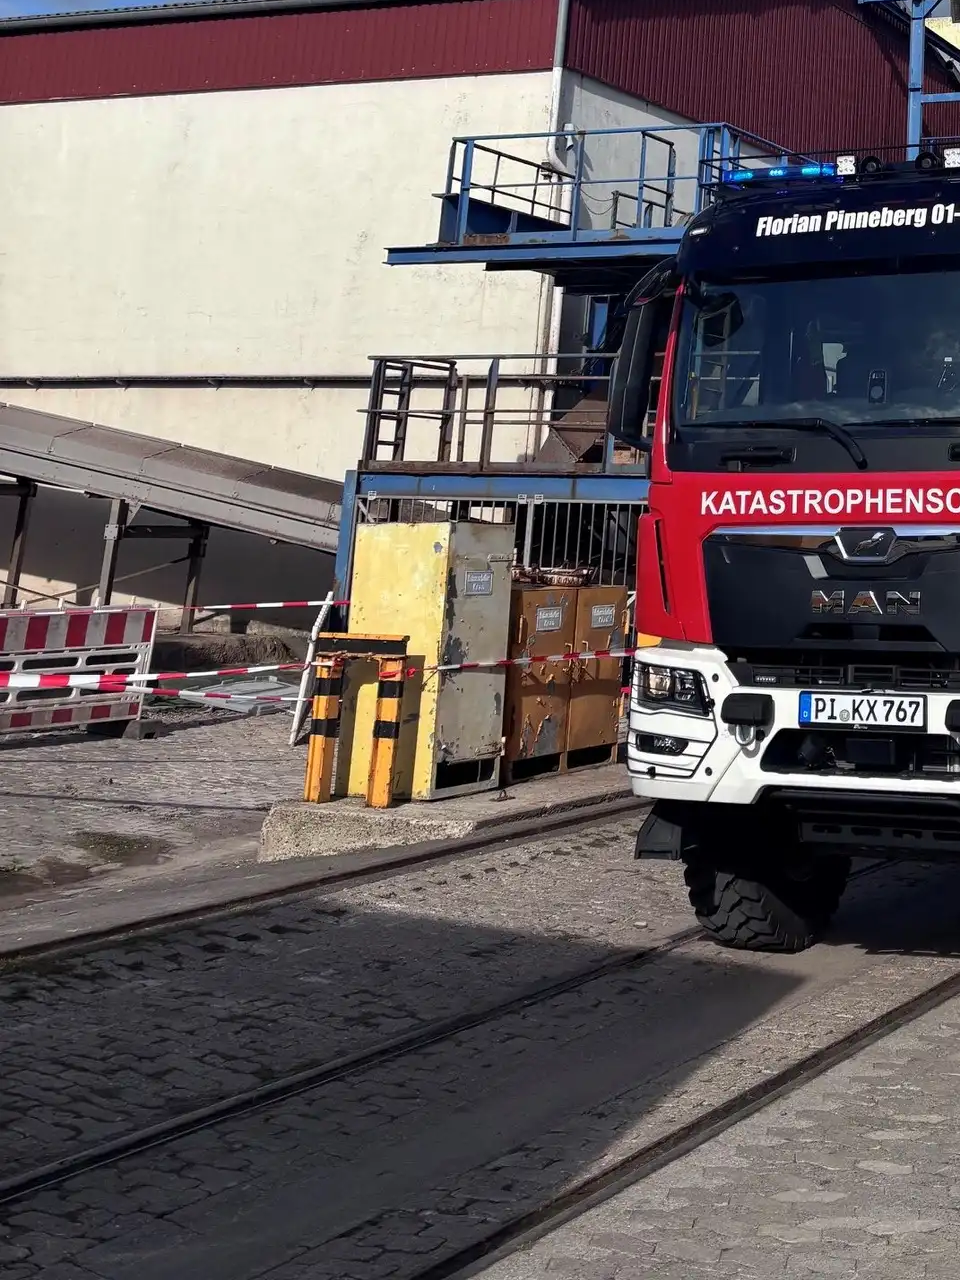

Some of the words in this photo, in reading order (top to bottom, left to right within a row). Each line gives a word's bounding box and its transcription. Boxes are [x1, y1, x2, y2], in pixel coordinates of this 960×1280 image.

[756, 214, 822, 237] Florian
[825, 205, 928, 231] Pinneberg
[810, 590, 921, 615] MAN
[814, 697, 838, 721] PI
[852, 699, 878, 722] KX
[883, 700, 920, 723] 767
